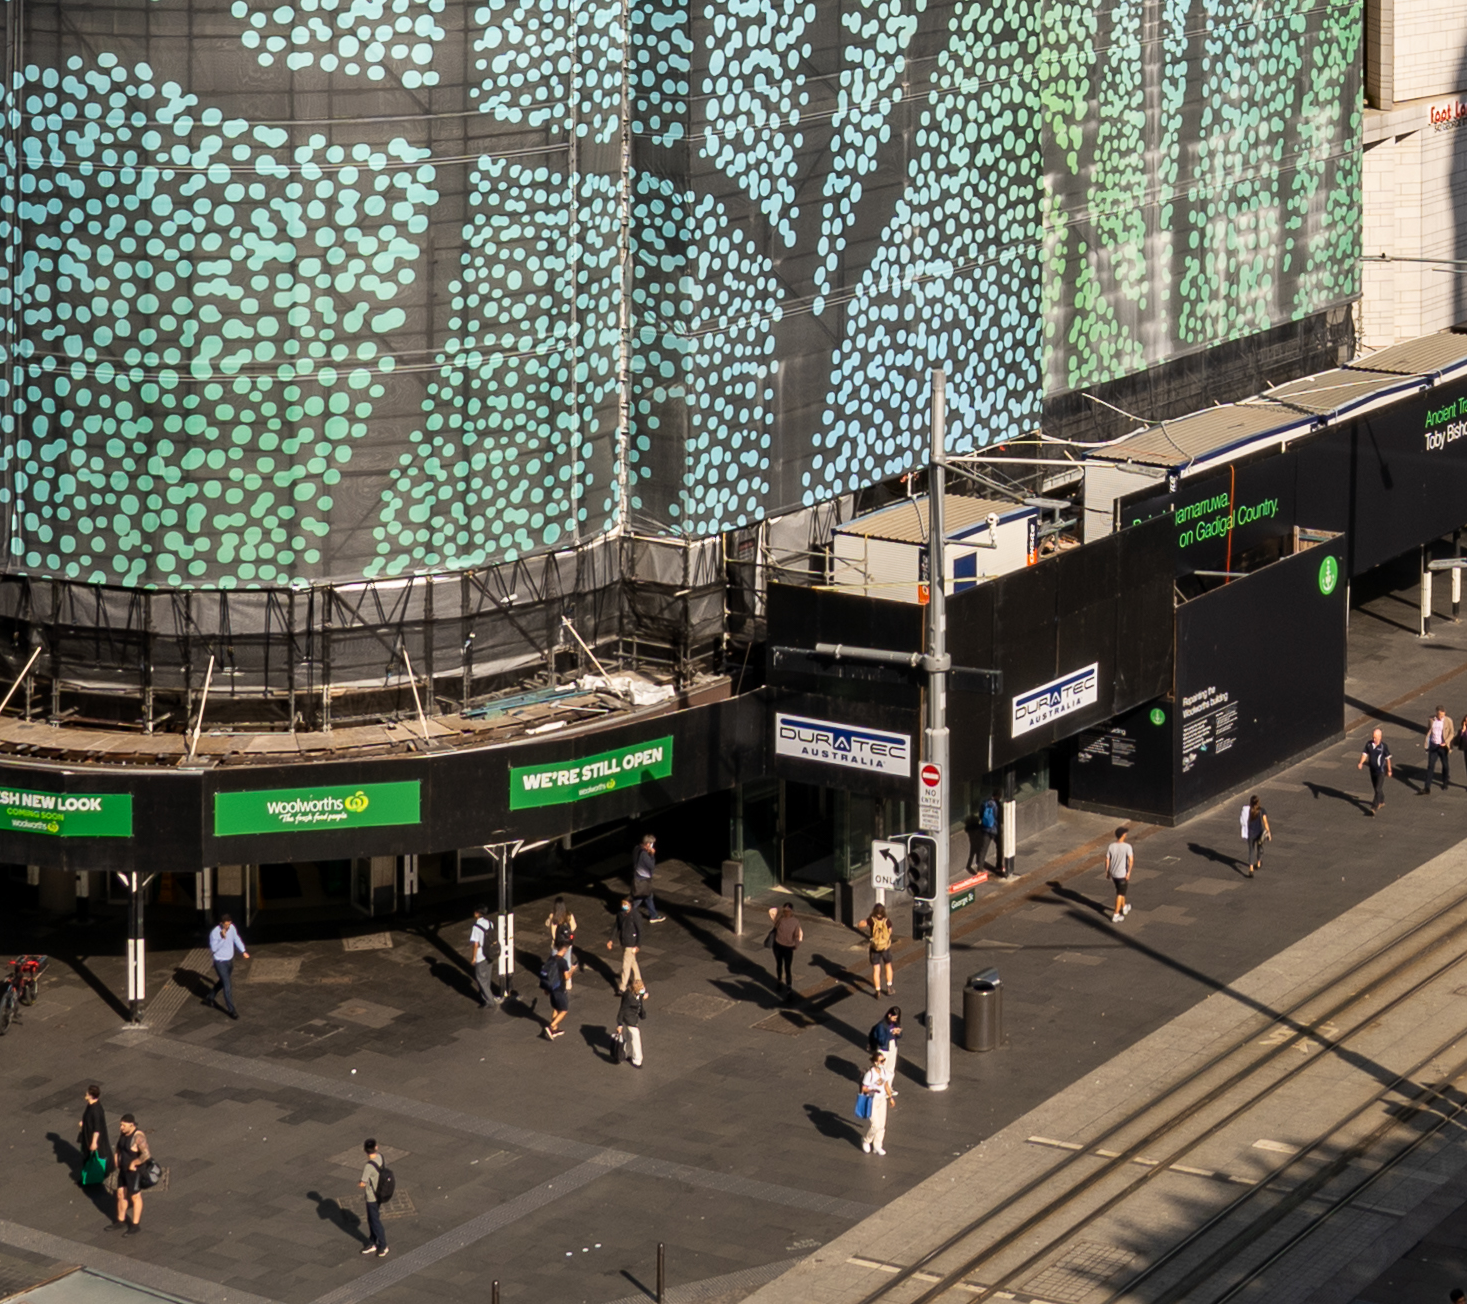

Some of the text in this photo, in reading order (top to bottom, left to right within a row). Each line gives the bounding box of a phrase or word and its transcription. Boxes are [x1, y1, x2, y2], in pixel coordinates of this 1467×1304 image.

[1430, 104, 1451, 124] Foot
[1424, 401, 1457, 429] Ancient
[1424, 429, 1446, 451] Toby
[1179, 530, 1193, 548] on
[1195, 510, 1235, 542] Gadigal
[1237, 497, 1279, 527] Country.
[1015, 676, 1095, 721] DURATEC
[1029, 697, 1082, 727] AUSTRALIA
[779, 726, 907, 760] DURATEC
[581, 758, 621, 781] STILL
[622, 746, 663, 771] OPEN
[801, 746, 885, 768] AUSTRALIA
[21, 793, 55, 811] NEW
[57, 797, 102, 812] LOOK
[925, 788, 936, 797] NO
[6, 807, 65, 821] COMING SOON
[279, 811, 348, 824] The fresh food people
[875, 875, 903, 886] ONLY
[951, 897, 968, 909] George
